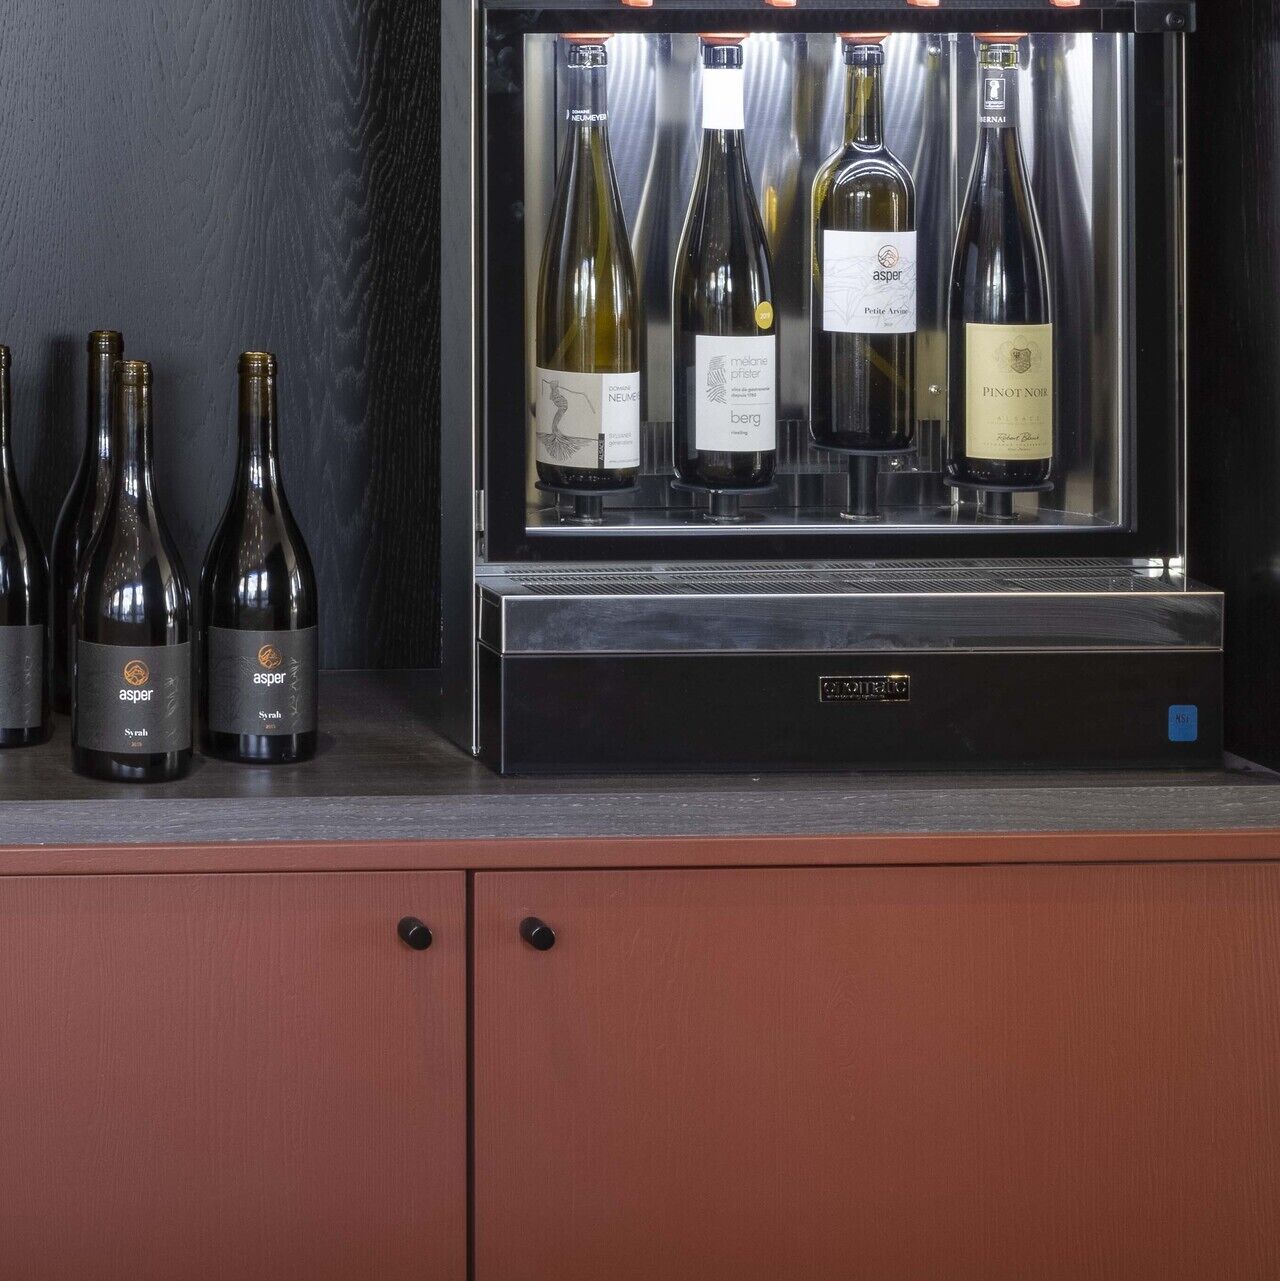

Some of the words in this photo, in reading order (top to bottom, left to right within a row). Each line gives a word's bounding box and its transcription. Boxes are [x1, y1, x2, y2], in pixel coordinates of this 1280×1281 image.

[572, 114, 607, 122] NEUMEYER
[872, 270, 902, 283] asper
[731, 355, 768, 366] mélanie
[730, 368, 761, 380] pfister
[983, 386, 1022, 398] PINOT
[1024, 386, 1048, 398] NOIR
[730, 410, 760, 426] berg
[254, 672, 286, 686] asper
[119, 689, 154, 704] asper
[258, 710, 282, 720] Syrah
[124, 728, 148, 738] Syrah
